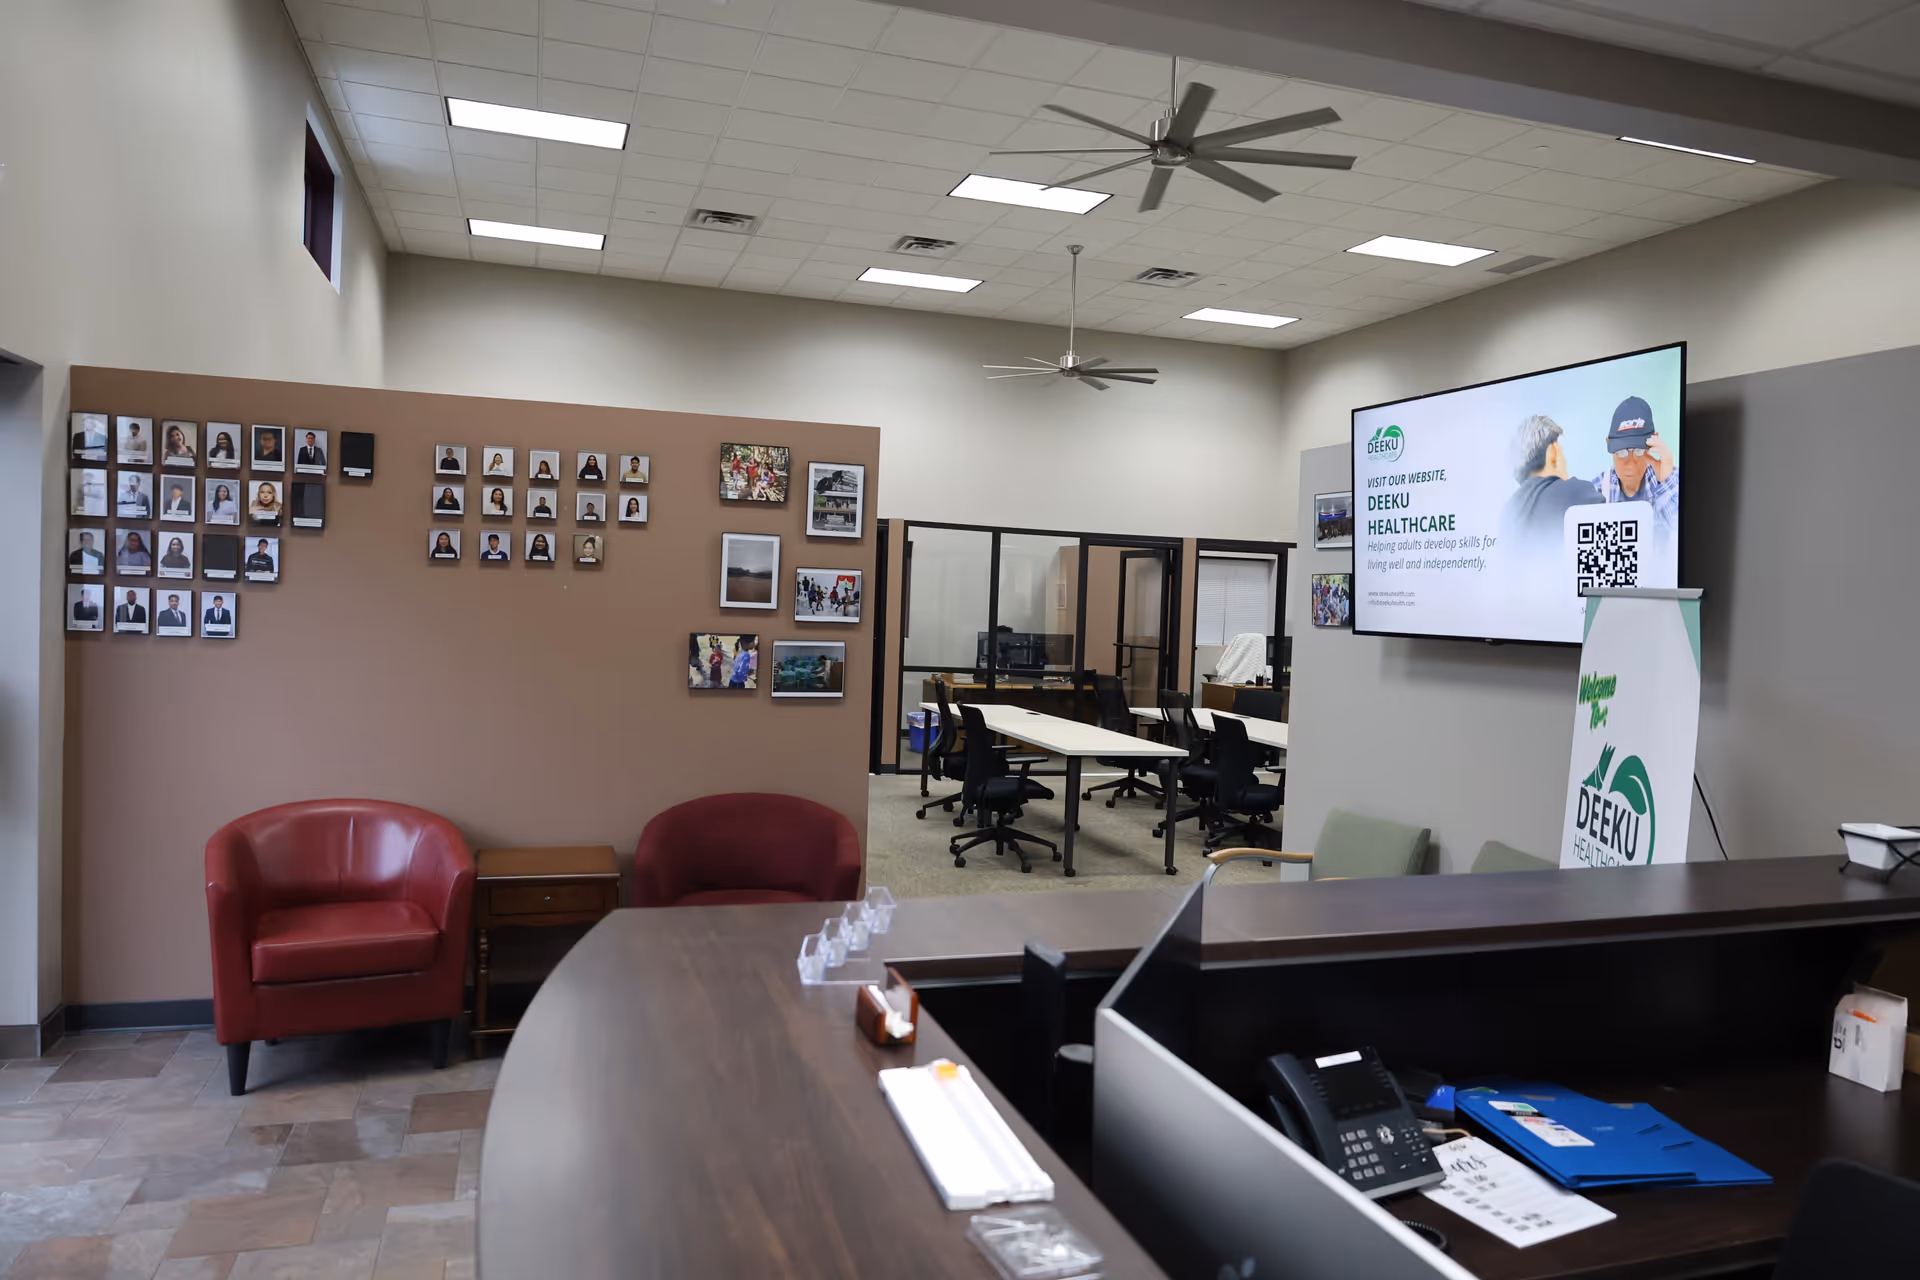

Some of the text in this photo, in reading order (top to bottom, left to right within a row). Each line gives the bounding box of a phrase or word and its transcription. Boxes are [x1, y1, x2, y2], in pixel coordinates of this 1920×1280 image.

[1367, 438, 1398, 454] DEEKU
[1367, 469, 1447, 489] VISIT OUR WEBSITE,
[1368, 492, 1410, 511] DEEKU
[1368, 514, 1456, 535] HEALTHCARE
[1367, 535, 1497, 554] Helping adults develop skills for
[1367, 556, 1487, 573] living well and independently.
[1578, 671, 1617, 705] Welcome
[1576, 786, 1640, 862] DEEKU
[1573, 833, 1625, 868] HEALTH
